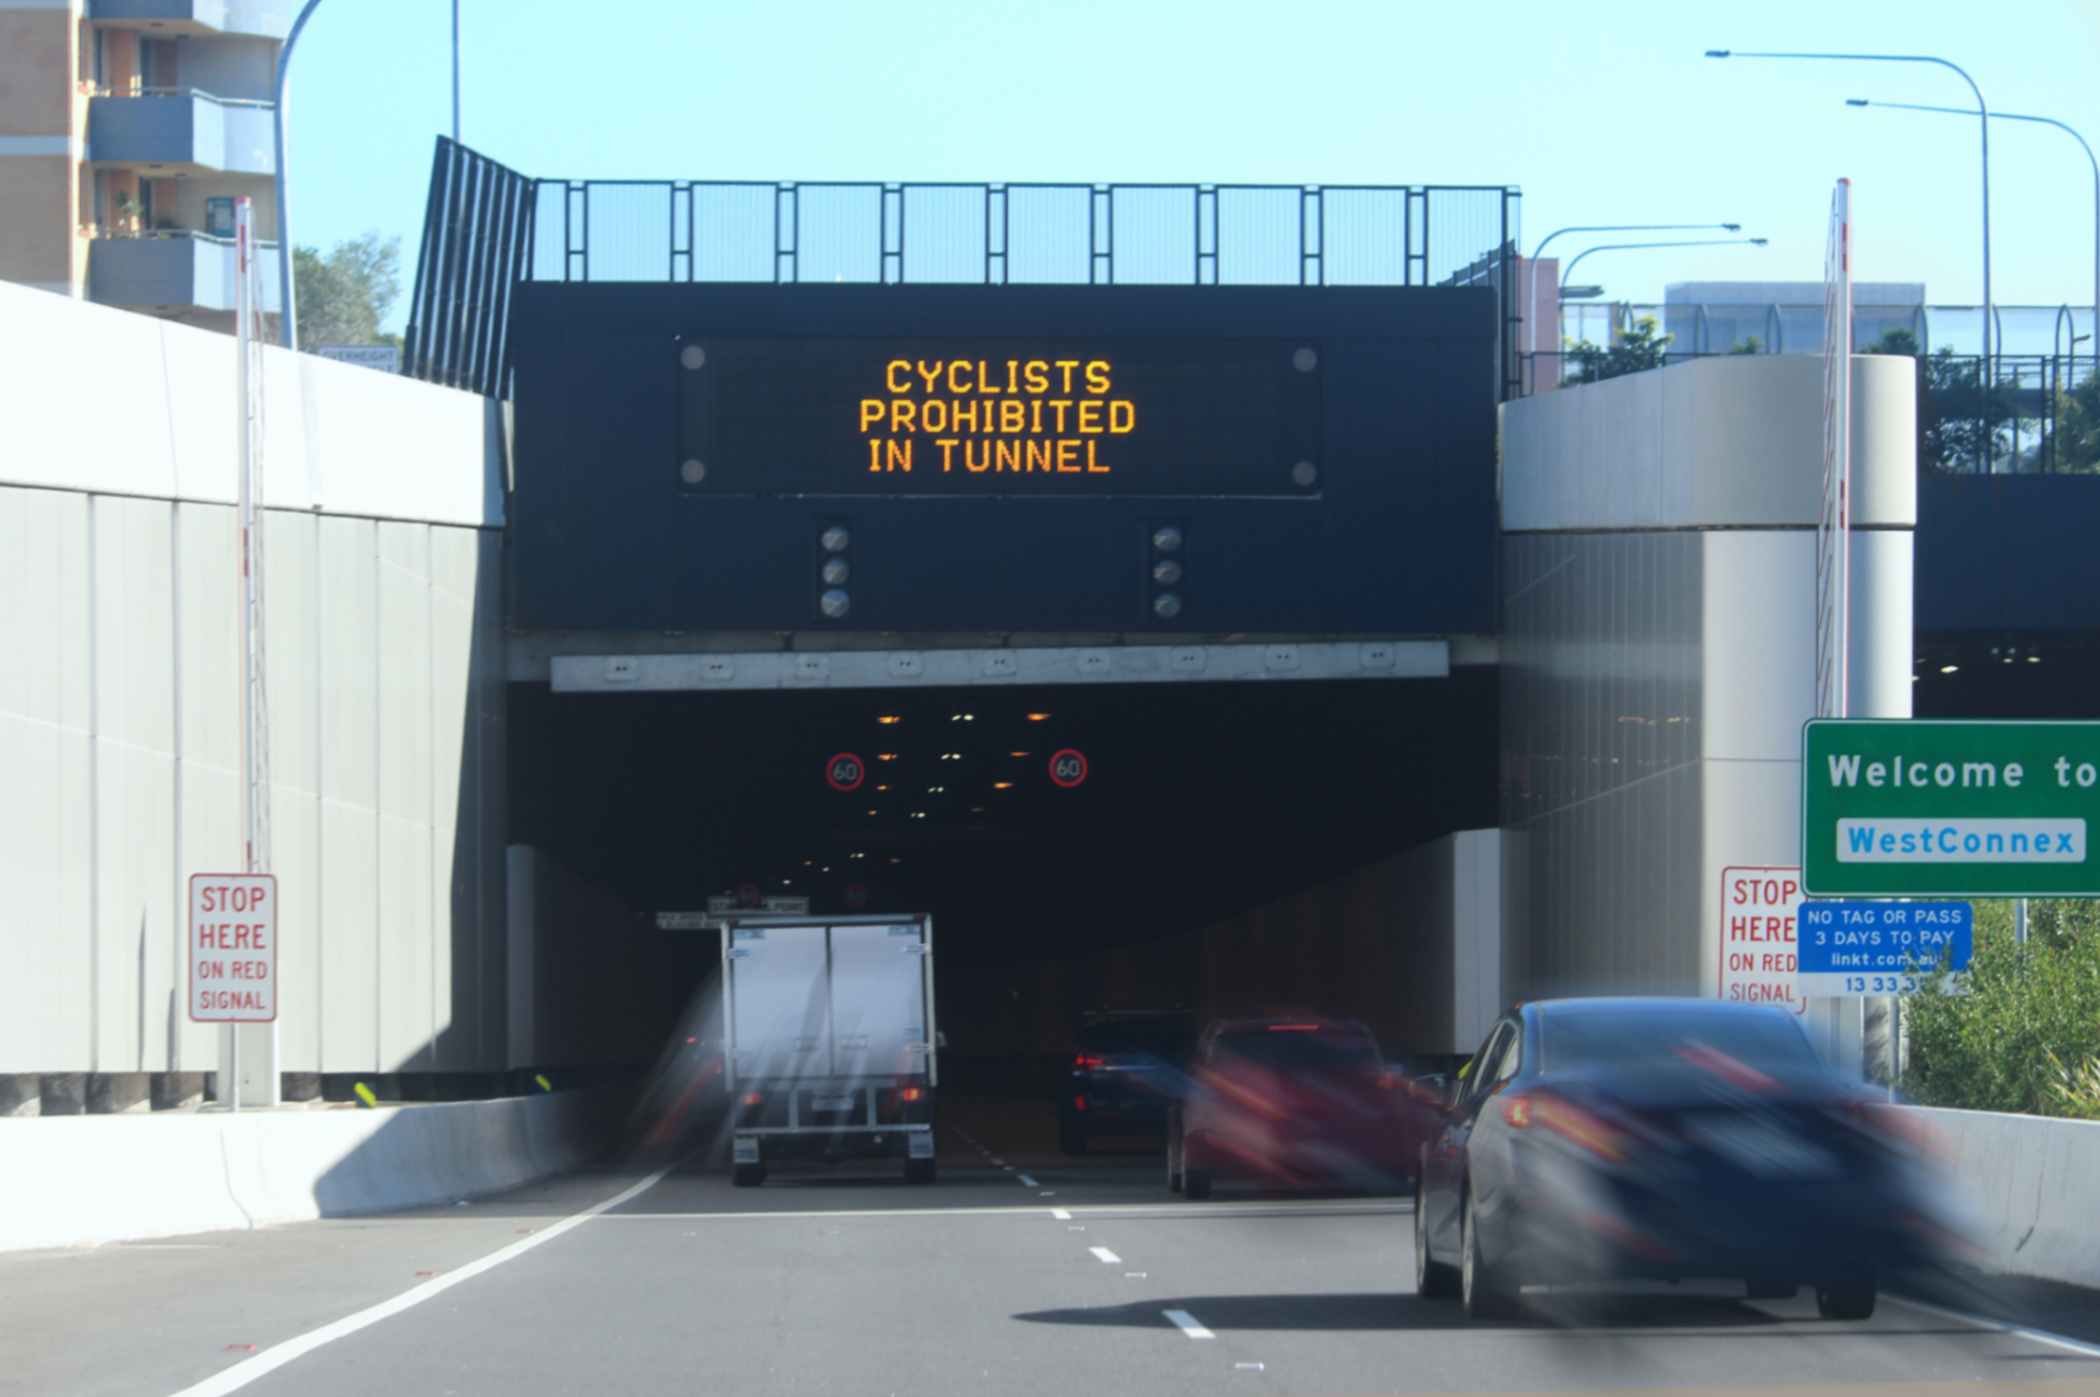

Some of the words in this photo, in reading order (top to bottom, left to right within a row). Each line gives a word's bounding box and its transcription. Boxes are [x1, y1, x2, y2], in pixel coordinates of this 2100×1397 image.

[885, 359, 1112, 394] CYCLISTS
[858, 398, 1136, 434] PROHIBITED
[868, 438, 913, 472] IN
[935, 438, 1111, 473] TUNNEL
[833, 763, 857, 780] 60
[1057, 757, 1080, 777] 60
[1827, 754, 2024, 788] Welcome
[2053, 755, 2097, 788] to
[1847, 826, 2075, 854] WestConnex
[200, 886, 266, 912] STOP
[1733, 879, 1798, 905] STOP
[1808, 910, 1832, 925] NO
[1842, 910, 1876, 925] TAG
[1883, 910, 1907, 925] OR
[1915, 910, 1963, 925] PASS
[199, 923, 267, 949] HERE
[1730, 915, 1797, 943] HERE
[1815, 931, 1827, 945] 3
[1834, 931, 1881, 945] DAYS
[1890, 931, 1912, 945] TO
[1919, 931, 1955, 945] PAY
[198, 960, 224, 979] ON
[231, 960, 268, 980] RED
[1729, 952, 1755, 972] ON
[1761, 953, 1797, 972] RED
[1831, 953, 1940, 967] linkt.coau
[1730, 982, 1796, 1003] SIGNAL
[1845, 976, 1865, 992] 13
[1872, 976, 1898, 992] 33
[200, 990, 267, 1010] SIGNAL
